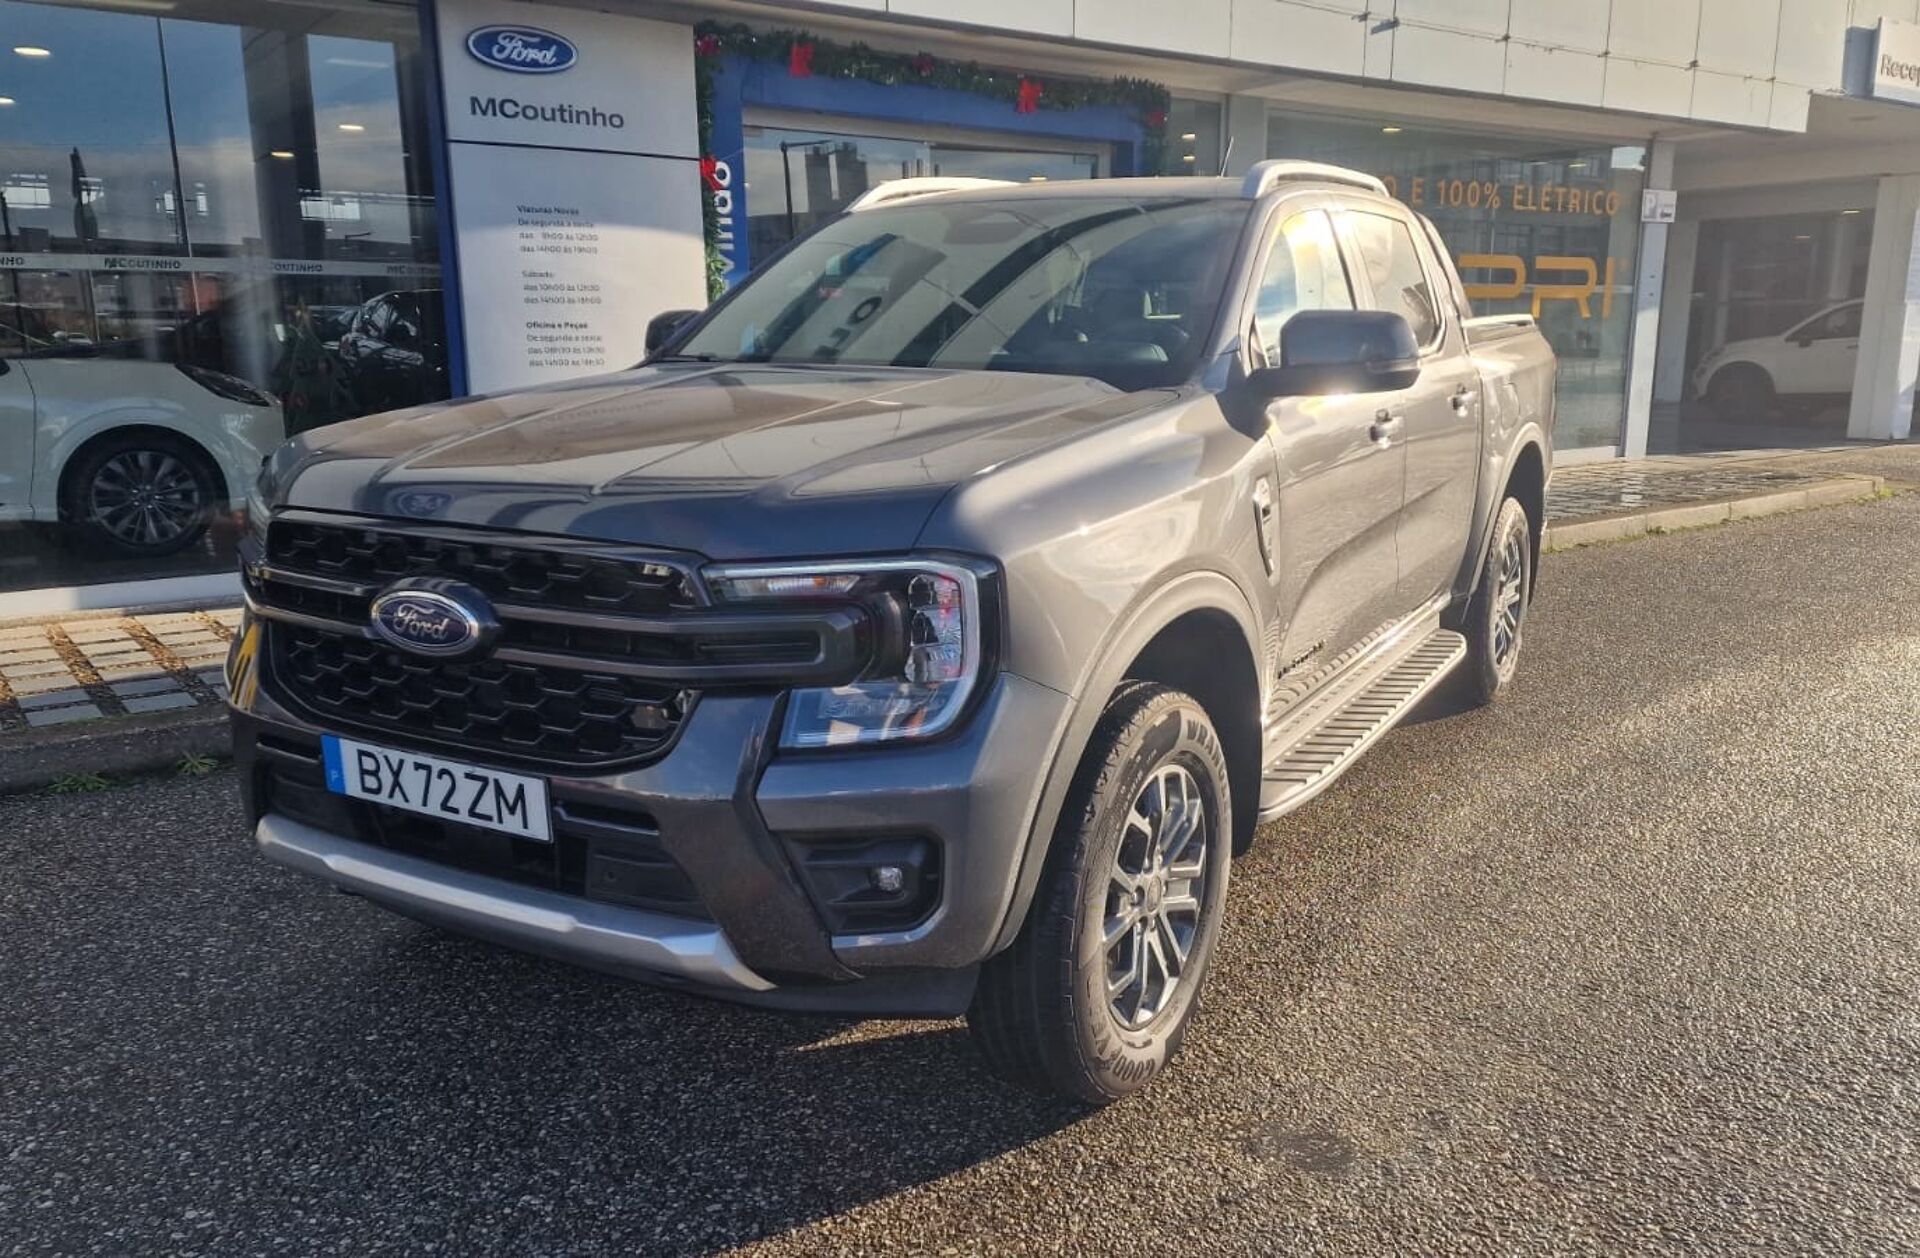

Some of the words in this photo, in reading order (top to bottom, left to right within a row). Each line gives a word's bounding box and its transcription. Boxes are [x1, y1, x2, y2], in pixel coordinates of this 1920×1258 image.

[491, 31, 557, 65] Ford
[470, 96, 625, 129] MCoutinho
[516, 205, 552, 214] Viaturas
[554, 206, 580, 216] Novas
[1412, 178, 1424, 205] E
[1438, 179, 1500, 209] 100%
[1512, 181, 1621, 216] ELÉTRICO
[564, 322, 588, 330] Peças
[393, 602, 448, 641] Ford
[356, 748, 529, 830] BX72ZM
